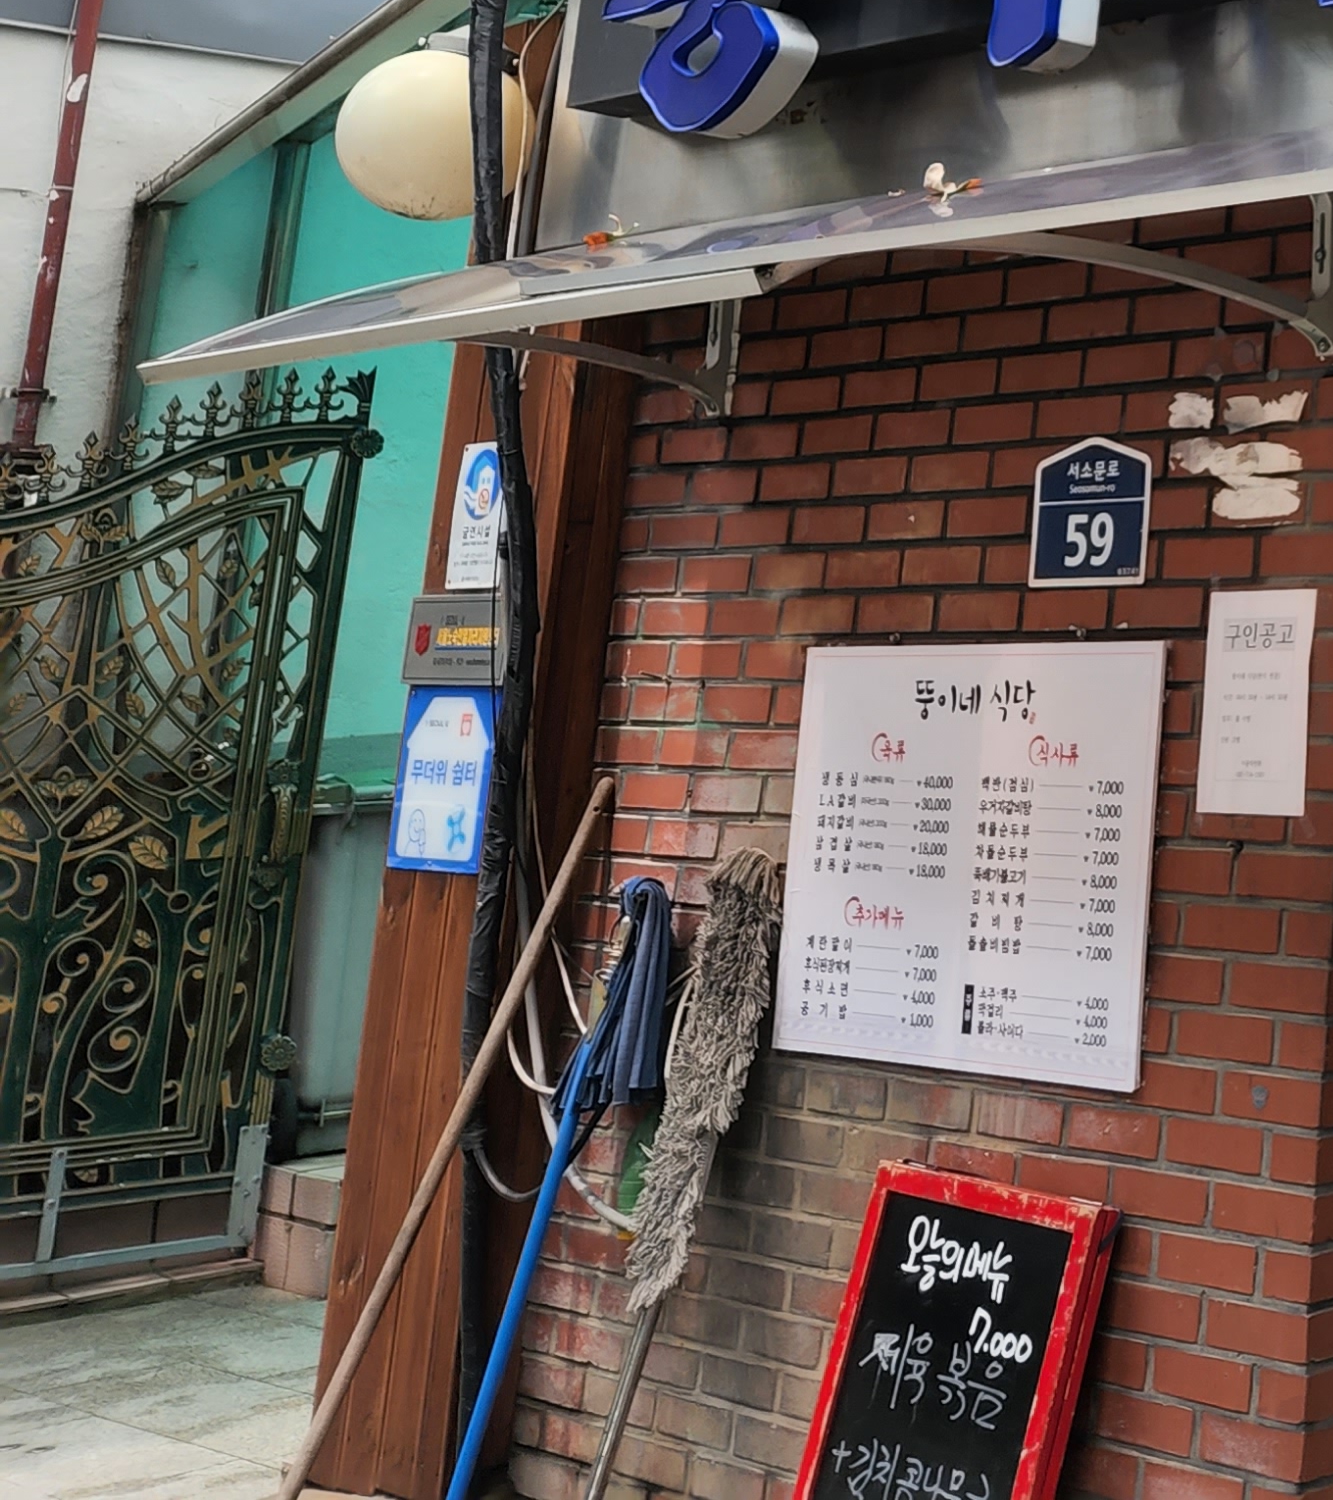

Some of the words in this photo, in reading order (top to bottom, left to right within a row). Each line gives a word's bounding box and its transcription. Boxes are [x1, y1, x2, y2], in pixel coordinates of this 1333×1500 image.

[1067, 460, 1120, 482] 서소문로
[1063, 512, 1114, 568] 59
[1225, 622, 1295, 649] 구인공고
[915, 680, 981, 720] 뚱이네
[989, 679, 1036, 722] 식당
[1036, 742, 1079, 767] 식사류
[411, 759, 448, 786] 무더위
[452, 760, 478, 787] 쉼터
[852, 903, 904, 931] 추가메뉴
